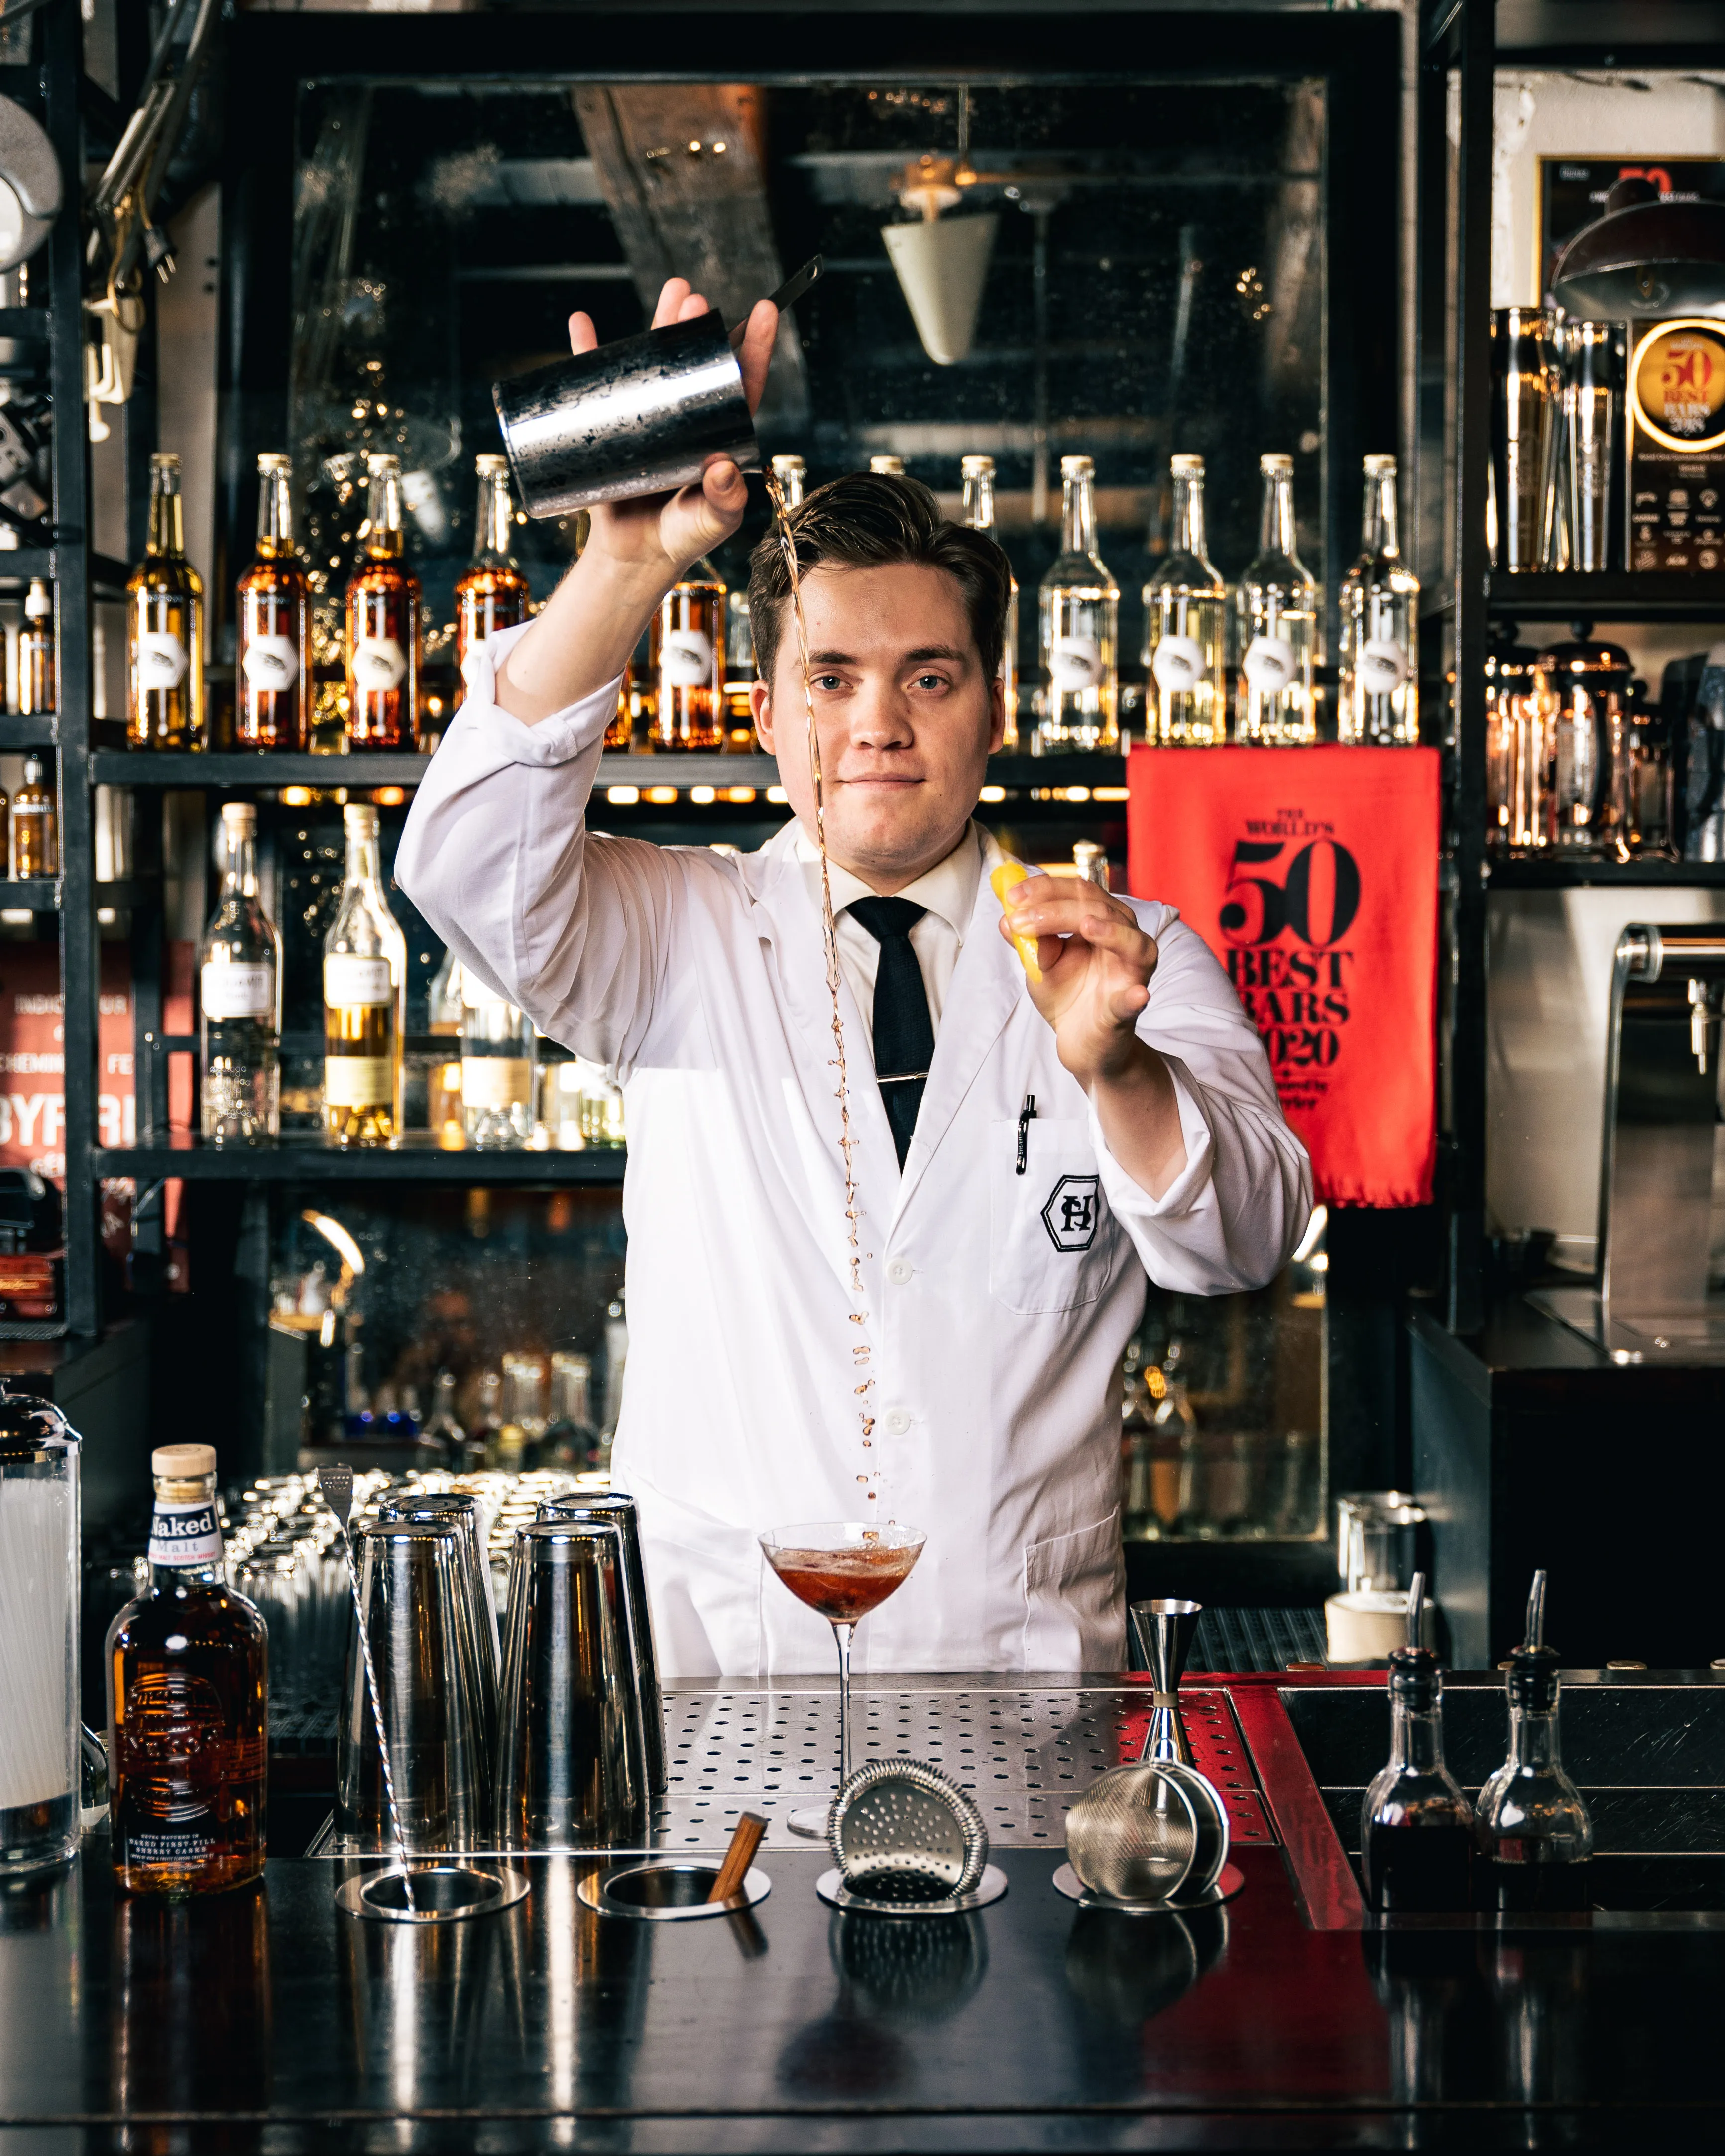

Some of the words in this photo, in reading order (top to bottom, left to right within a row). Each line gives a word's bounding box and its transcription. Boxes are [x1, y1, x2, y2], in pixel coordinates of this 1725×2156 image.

[1662, 350, 1712, 389] 50
[1219, 839, 1361, 946] 50
[1228, 949, 1354, 988] BEST
[1263, 1028, 1339, 1067] 020
[156, 1541, 198, 1553] Malt
[129, 1838, 156, 1847] NAKED
[160, 1838, 216, 1848] FIRST-FILL
[136, 1846, 170, 1855] SHERRY
[175, 1846, 207, 1855] CASKS
